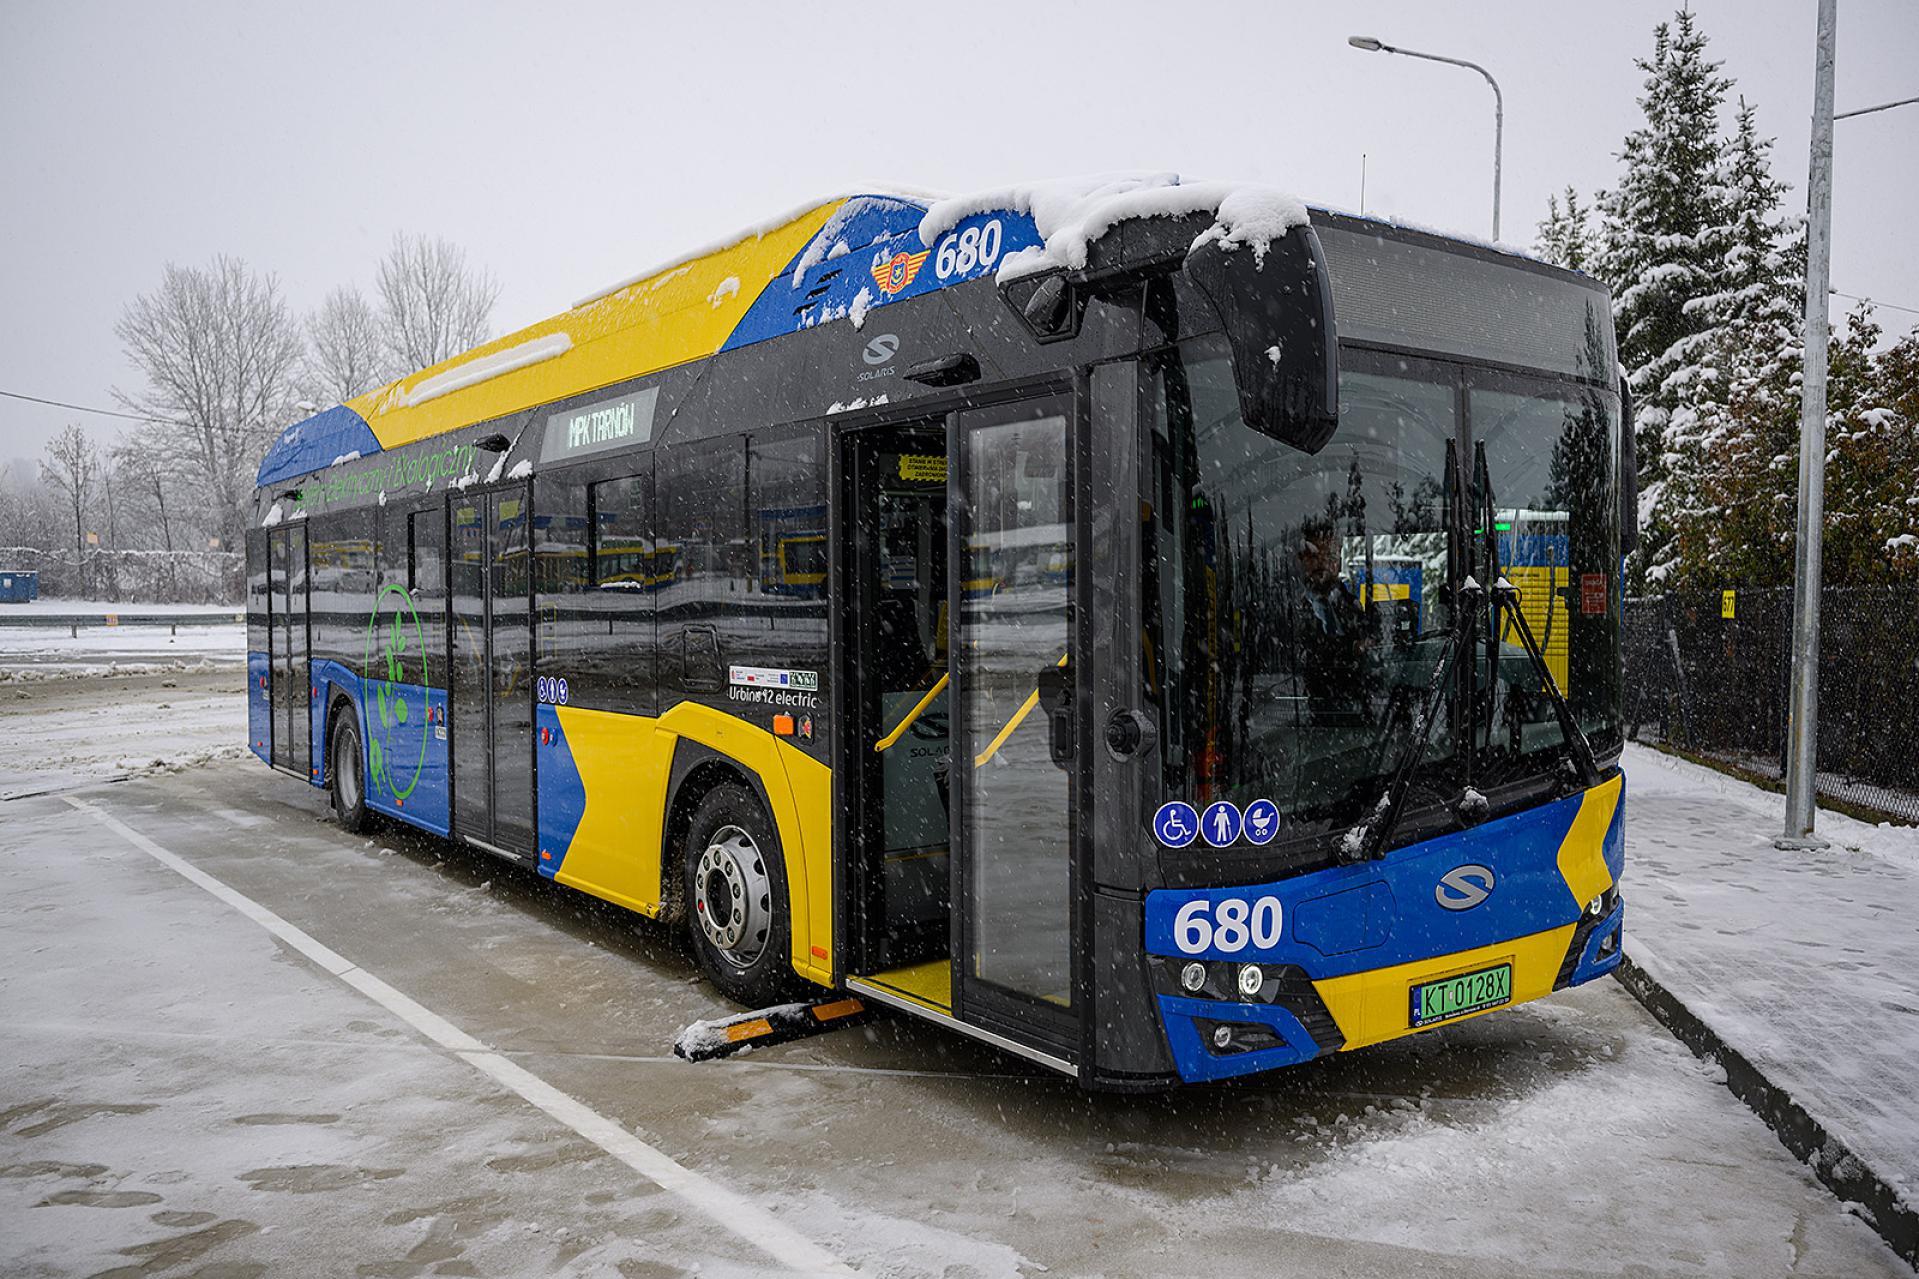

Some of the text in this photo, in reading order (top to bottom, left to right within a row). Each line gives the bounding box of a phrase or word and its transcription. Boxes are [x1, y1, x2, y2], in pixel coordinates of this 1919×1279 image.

[935, 219, 1003, 280] 680
[857, 366, 896, 383] SOLARIS
[568, 402, 635, 449] MPK TARNÓW
[393, 443, 477, 488] Ekologiczny
[1723, 596, 1734, 613] 677
[729, 686, 818, 709] Urbino 12 electric
[1173, 895, 1283, 955] 680
[1425, 969, 1506, 1016] KT 0128X
